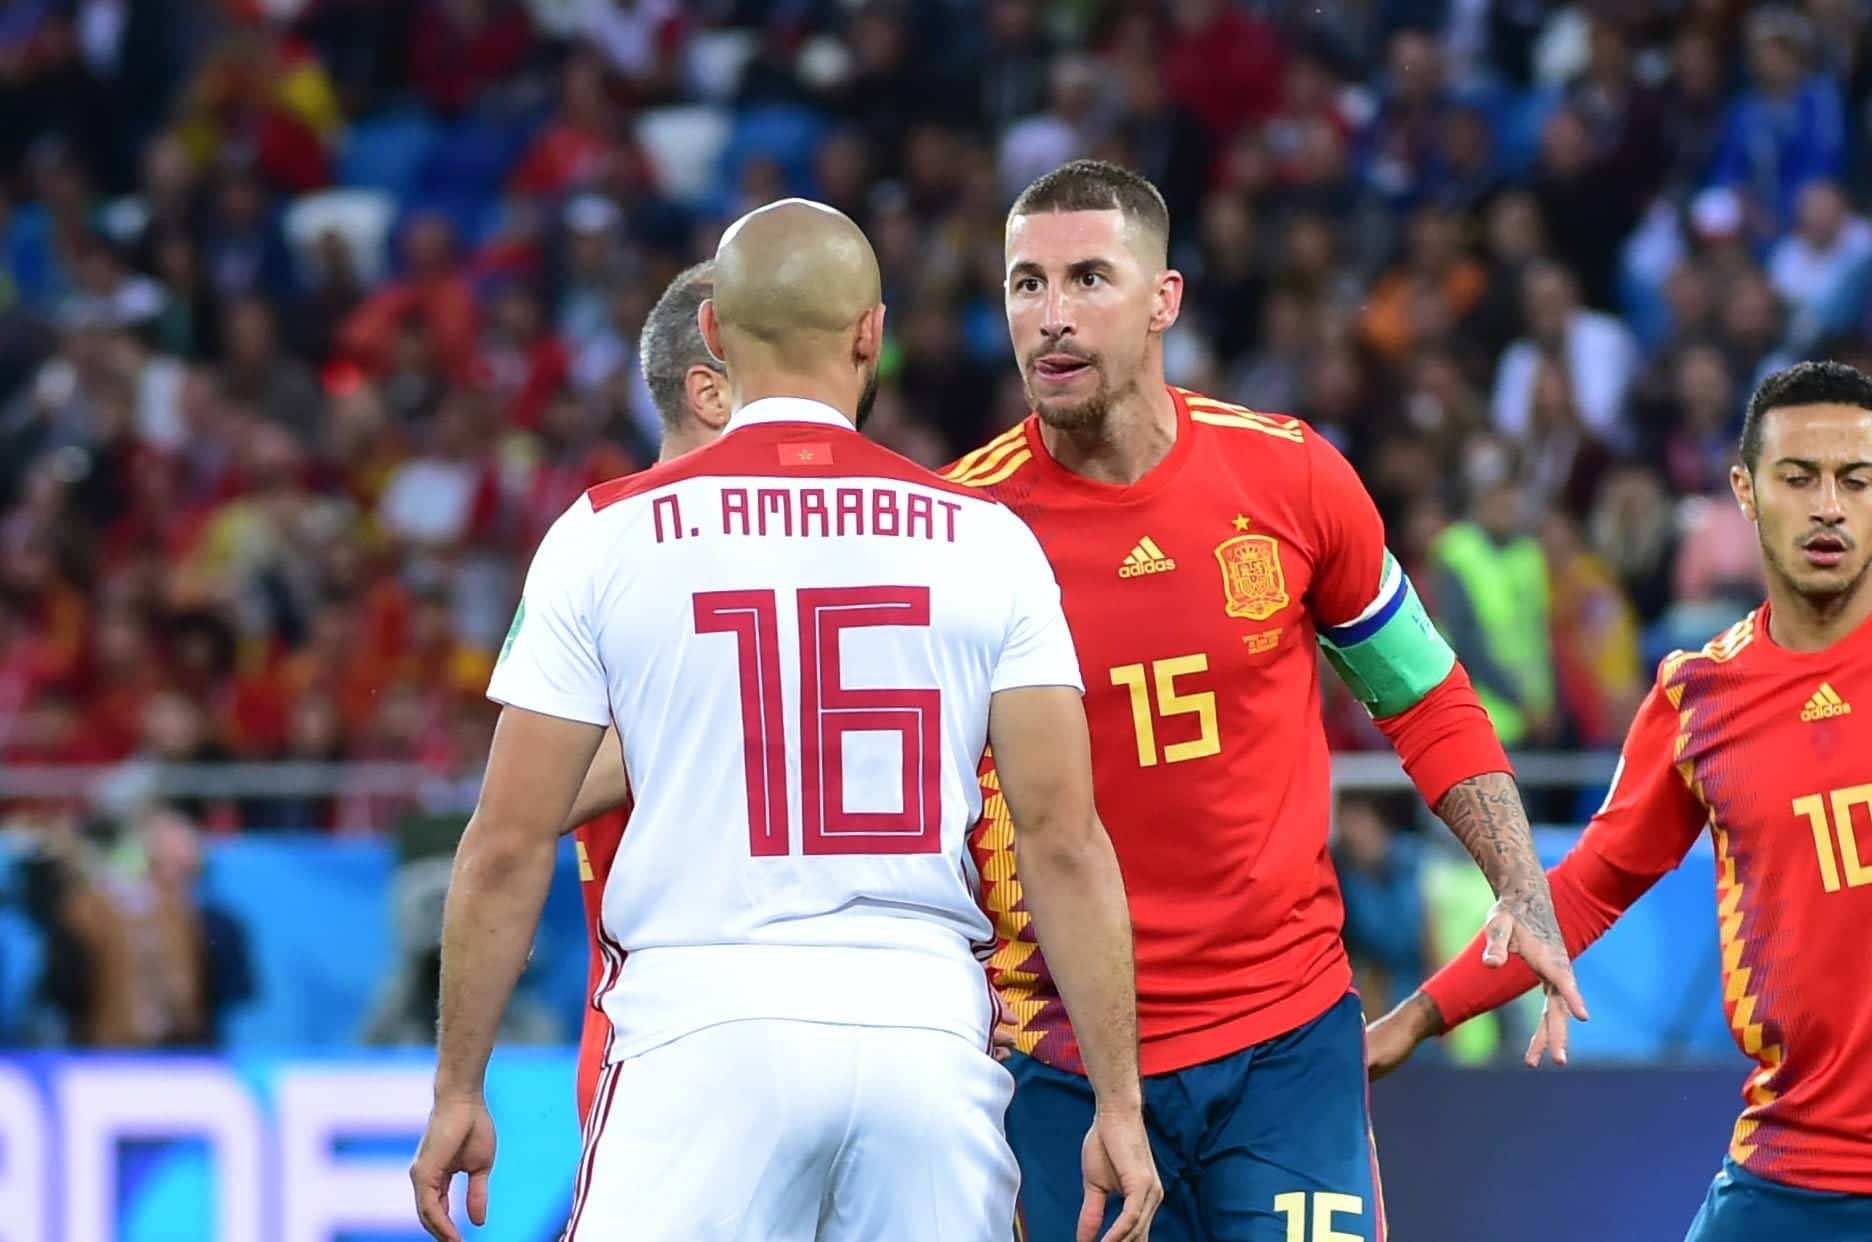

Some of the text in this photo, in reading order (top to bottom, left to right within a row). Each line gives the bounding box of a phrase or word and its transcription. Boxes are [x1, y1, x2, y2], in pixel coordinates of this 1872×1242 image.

[721, 488, 962, 543] AMRABAT
[1118, 559, 1176, 578] adidas
[692, 586, 942, 856] 16
[1109, 653, 1222, 767] 15
